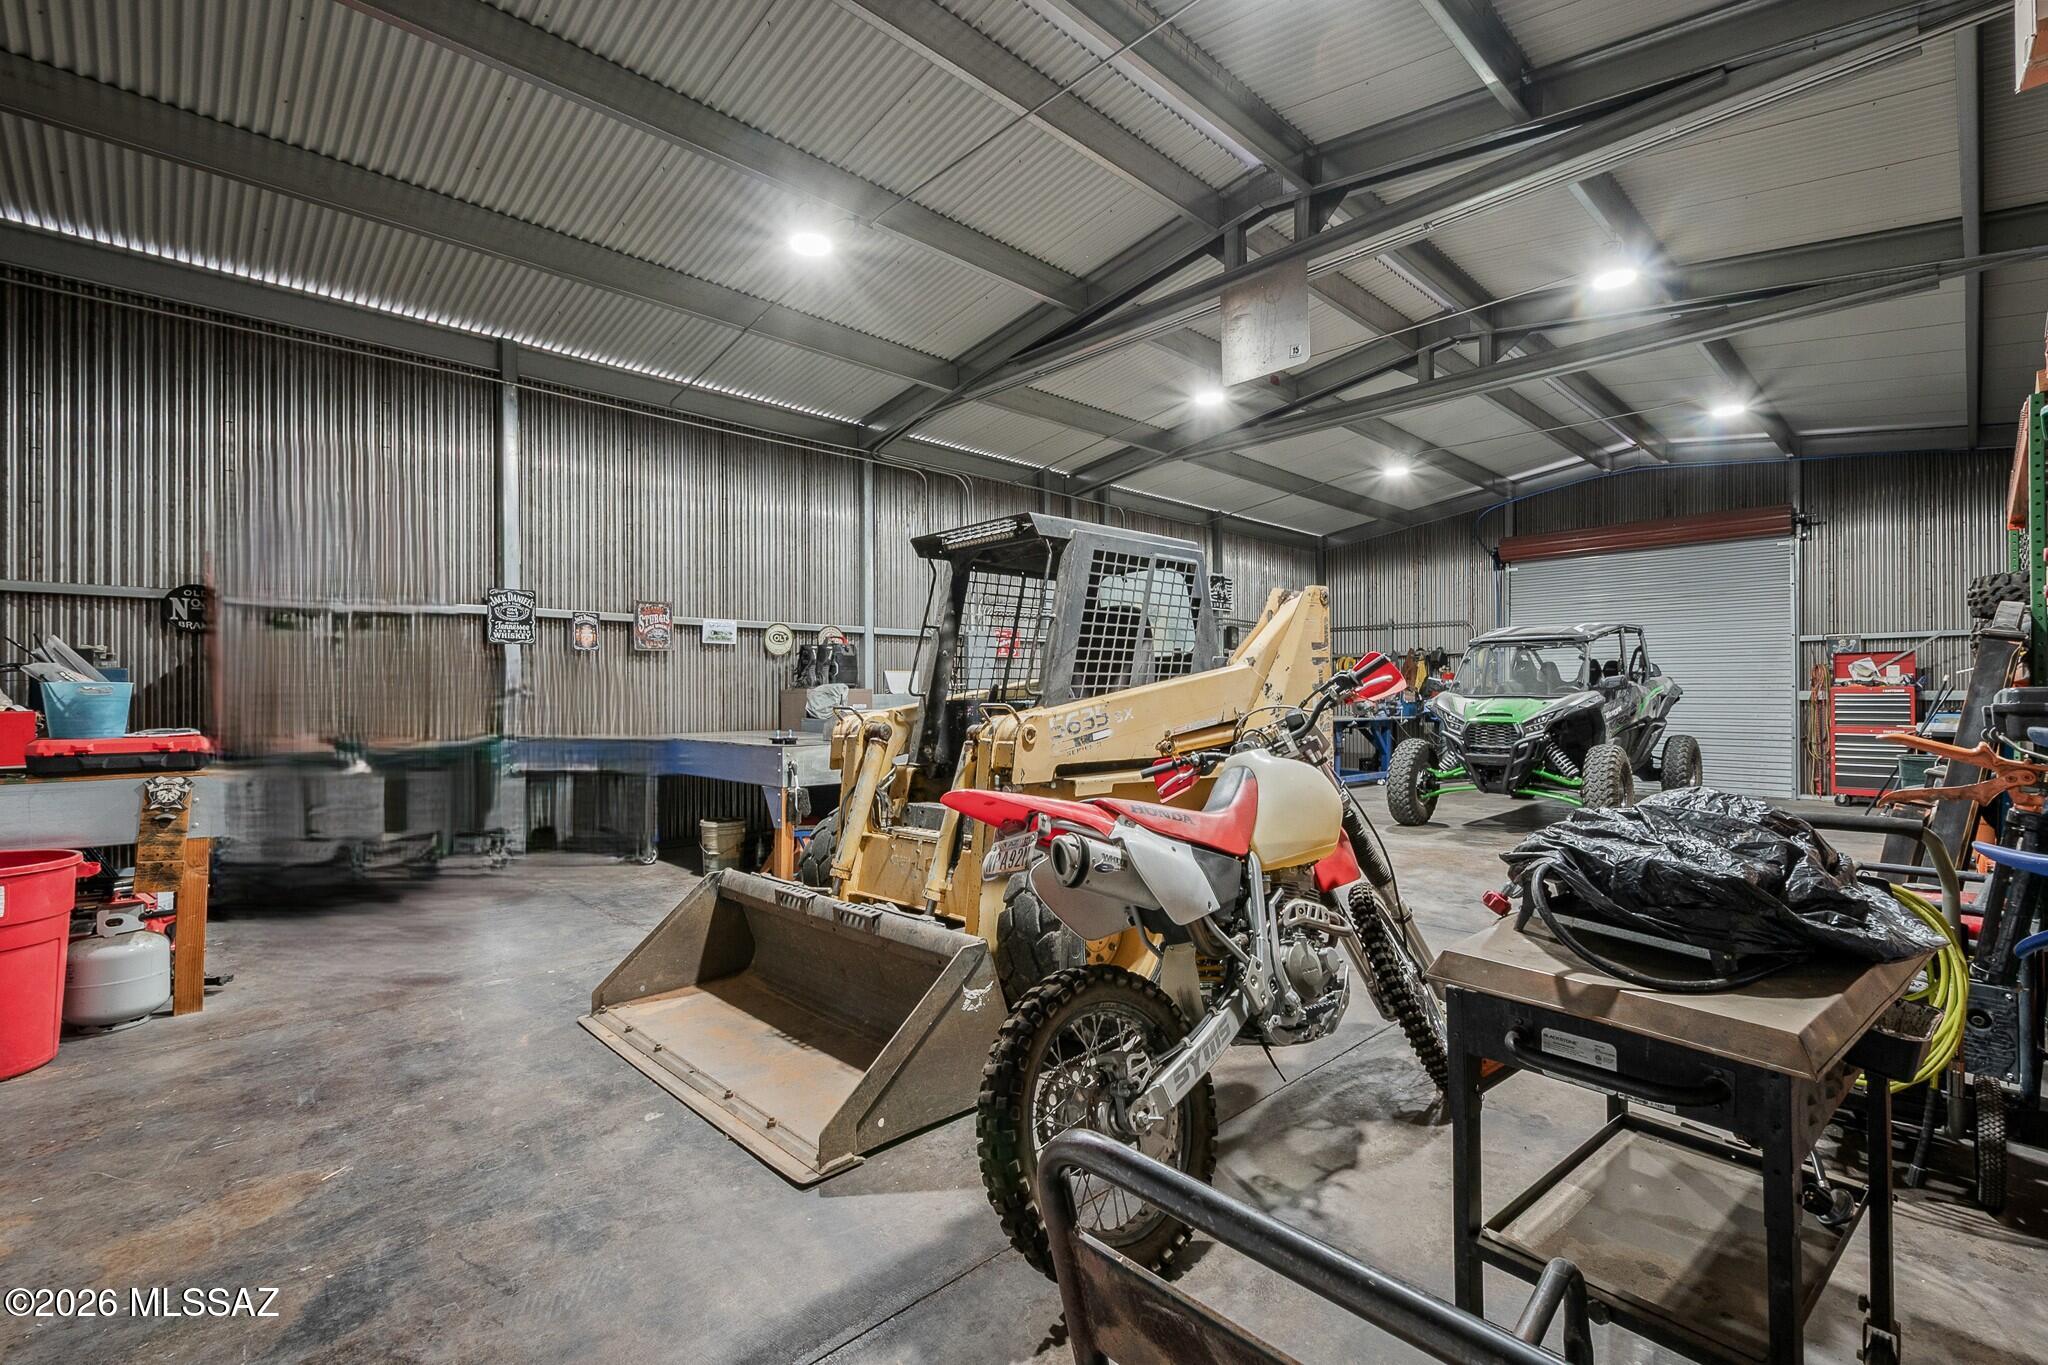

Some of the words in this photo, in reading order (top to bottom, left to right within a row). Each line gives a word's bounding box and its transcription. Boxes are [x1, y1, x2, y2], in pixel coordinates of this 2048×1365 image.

[490, 594, 508, 607] JACK
[494, 620, 530, 630] Tennessee
[638, 613, 670, 633] STURGIS
[493, 631, 531, 640] WHISKEY
[1131, 804, 1195, 825] HONDA
